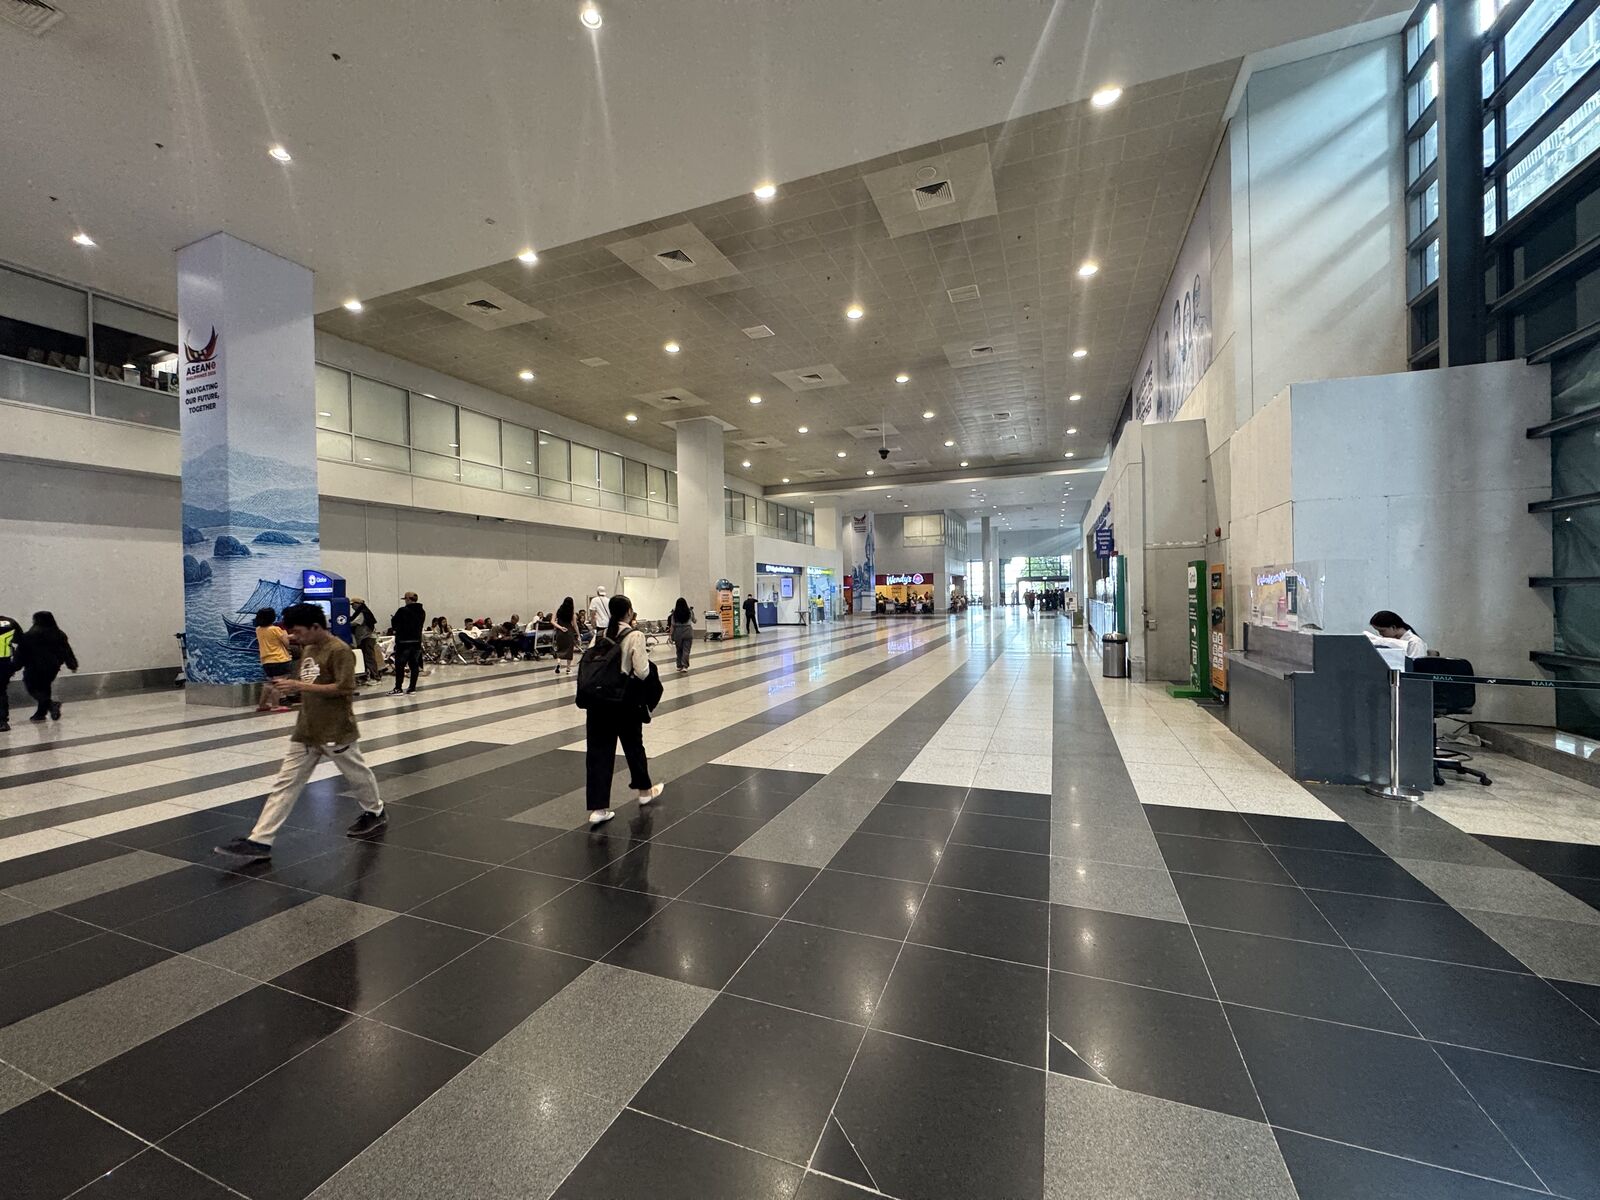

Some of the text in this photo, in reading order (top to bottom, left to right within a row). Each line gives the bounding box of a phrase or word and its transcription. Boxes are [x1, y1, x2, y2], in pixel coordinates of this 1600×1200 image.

[186, 362, 210, 376] ASEAN
[186, 382, 218, 394] NAVIGATING
[185, 397, 196, 405] OUR
[189, 403, 216, 413] TOGETHER
[886, 573, 912, 585] Wendy's
